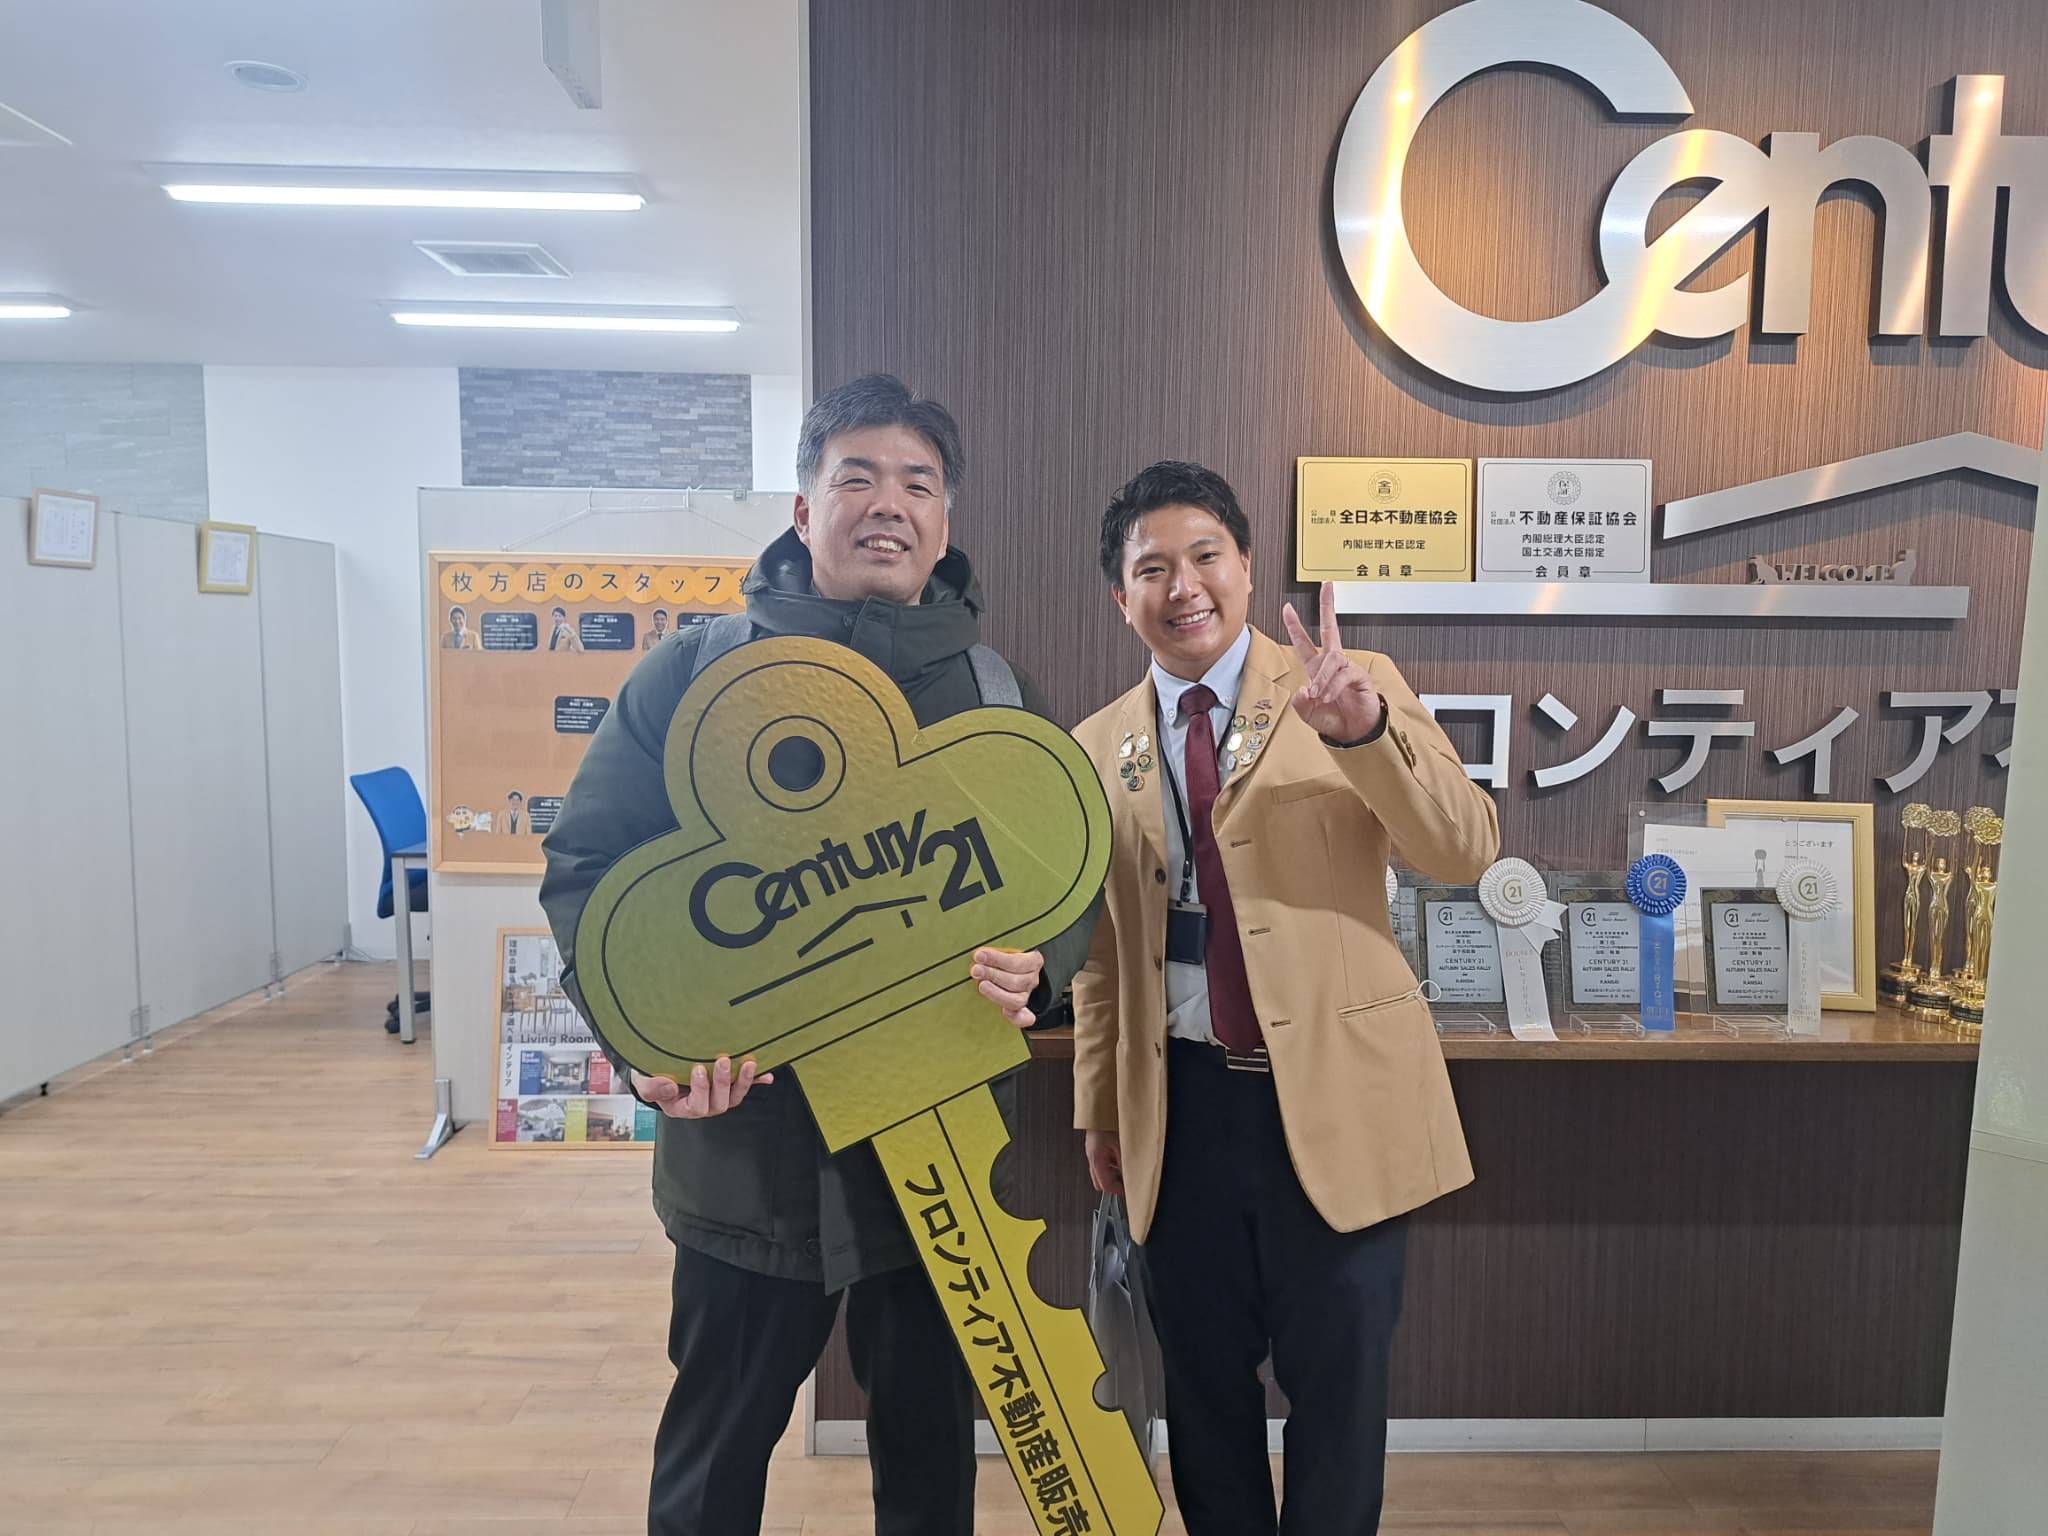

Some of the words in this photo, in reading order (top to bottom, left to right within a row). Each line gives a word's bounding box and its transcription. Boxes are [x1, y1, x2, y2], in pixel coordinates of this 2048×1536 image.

[1334, 0, 2048, 392] Cent
[1339, 509, 1458, 525] 全日本不動産協会
[1519, 510, 1637, 526] 不動産保証協会
[1343, 539, 1426, 550] 内閣総理大臣認定
[1522, 533, 1605, 544] 内閣総理大臣認定
[1522, 547, 1605, 558] 国土交通大臣指定
[1774, 563, 1896, 582] WELCOME
[1418, 688, 2016, 794] ロンティア
[689, 808, 927, 949] Century
[919, 816, 1004, 912] 21
[521, 1034, 557, 1046] Living
[561, 1034, 595, 1044] Room
[904, 1162, 1092, 1536] フロンティア不動産販売
